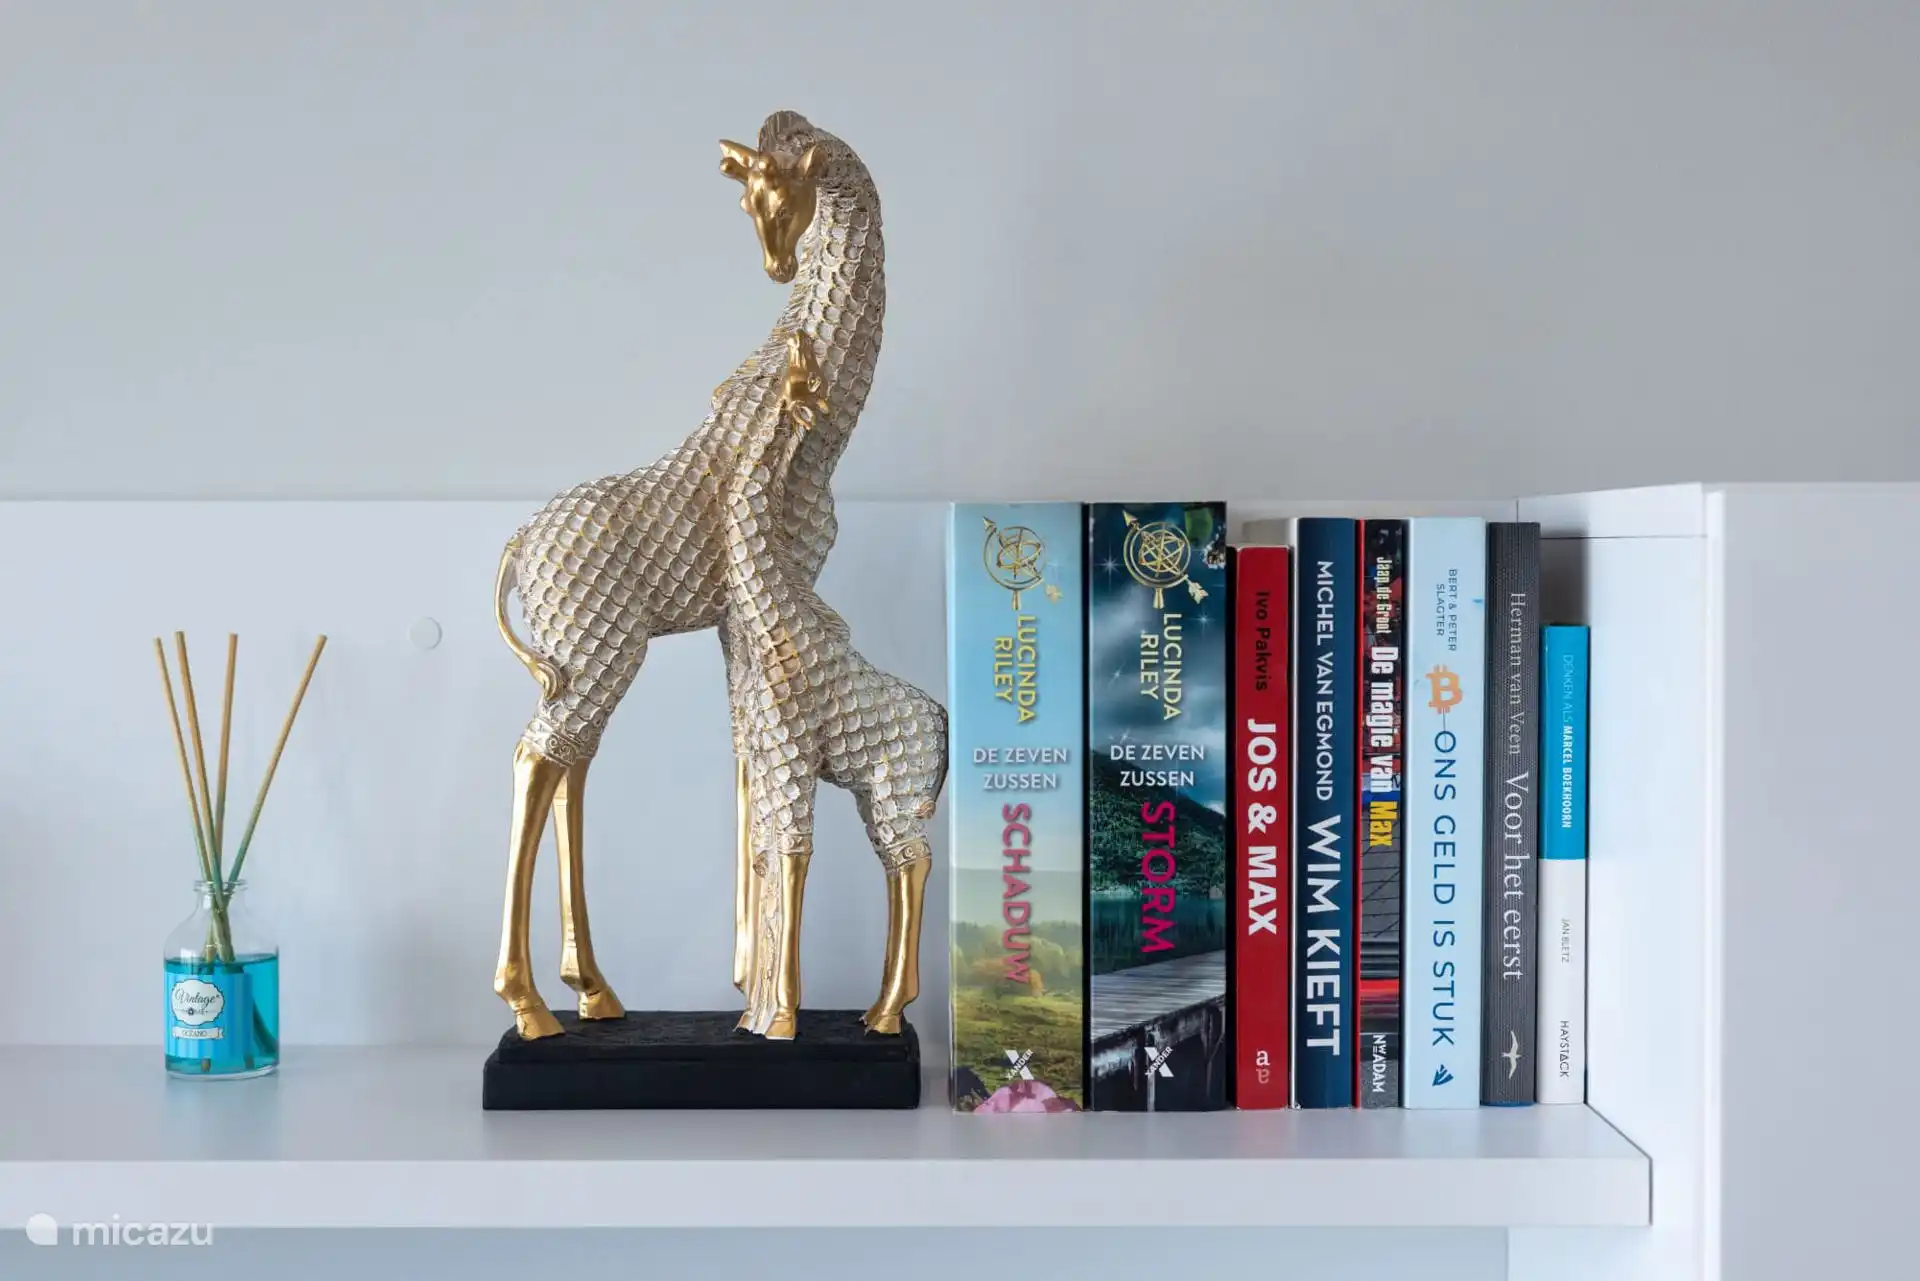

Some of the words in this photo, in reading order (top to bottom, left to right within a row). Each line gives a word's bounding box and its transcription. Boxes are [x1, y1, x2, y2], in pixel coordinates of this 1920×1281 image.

[1374, 556, 1392, 584] Jaap
[1448, 569, 1458, 600] BERT
[1256, 591, 1269, 620] Ivo
[1317, 560, 1334, 646] MICHEL
[1376, 586, 1392, 600] de
[1436, 584, 1445, 637] SLAGTER
[1376, 603, 1392, 634] Groot
[1448, 614, 1457, 651] PETER
[1510, 593, 1526, 667] Herman
[994, 636, 1013, 702] RILEY
[1017, 614, 1036, 723] LUCINDA
[1140, 633, 1159, 700] RILEY
[1163, 613, 1182, 720] LUCINDA
[1256, 627, 1272, 691] Pakvis
[1316, 652, 1333, 695] VAN
[1371, 646, 1398, 674] De
[1563, 654, 1574, 698] DENKEN
[1509, 673, 1522, 705] van
[1366, 682, 1394, 748] magie
[1509, 711, 1525, 756] Veen
[1562, 702, 1573, 723] ALS
[973, 748, 998, 763] DE
[1003, 748, 1067, 763] ZEVEN
[1110, 745, 1136, 760] DE
[1141, 745, 1205, 760] ZEVEN
[1247, 718, 1277, 792] JOS
[1316, 701, 1333, 800] EGMOND
[1434, 730, 1456, 800] ONS
[1563, 725, 1574, 765] MARCEL
[983, 774, 1057, 789] ZUSSEN
[1120, 771, 1194, 786] ZUSSEN
[1370, 754, 1393, 793] van
[1247, 802, 1277, 834] &
[1504, 771, 1529, 845] Voor
[1561, 767, 1573, 828] BOEKHOORN
[1369, 801, 1397, 846] Max
[1140, 801, 1176, 953] STORM
[1307, 814, 1341, 913] WIM
[1433, 815, 1456, 905] GELD
[1503, 853, 1531, 900] het
[1002, 803, 1031, 984] SCHADUW
[1248, 846, 1277, 936] MAX
[1433, 920, 1455, 948] IS
[1503, 909, 1523, 981] eerst
[1561, 918, 1570, 934] JAN
[174, 988, 216, 1008] Vintage
[1306, 929, 1341, 1056] KIEFT
[1432, 961, 1455, 1046] STUK
[1004, 1048, 1034, 1080] XANDER
[1144, 1046, 1173, 1077] XANDER
[1559, 1020, 1570, 1077] HAYSTACK
